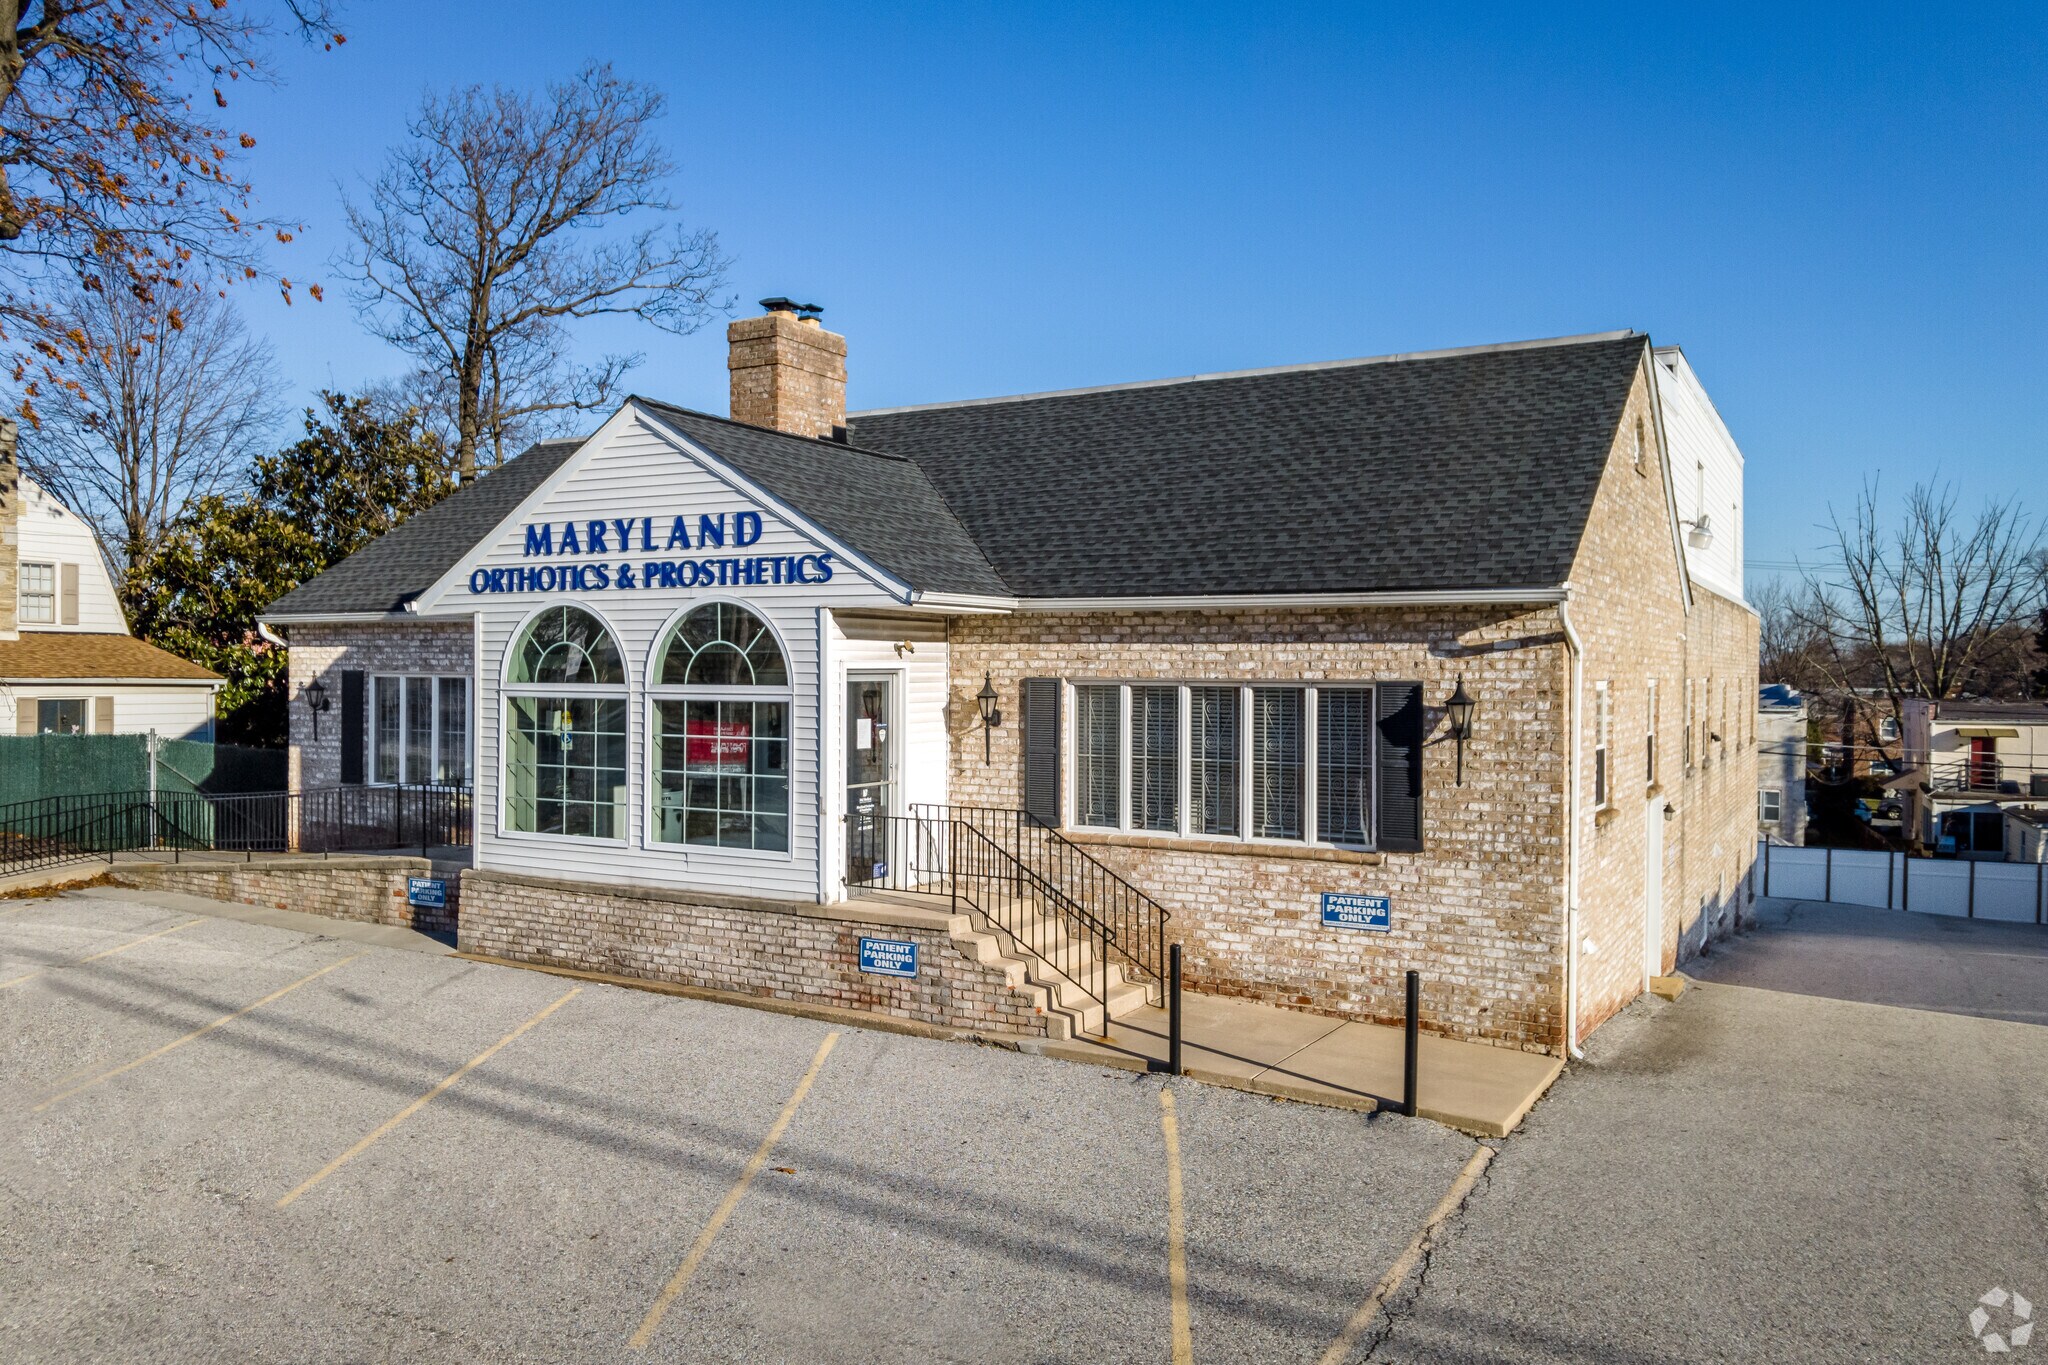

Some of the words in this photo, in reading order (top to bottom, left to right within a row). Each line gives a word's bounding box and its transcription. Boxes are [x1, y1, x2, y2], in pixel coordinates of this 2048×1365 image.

[523, 511, 763, 557] MARYLAND
[469, 563, 610, 594] ORTHOTICS
[615, 563, 637, 589] &
[642, 553, 834, 588] PROSTHETICS
[412, 880, 442, 889] PATIENT
[411, 887, 443, 896] PARKING
[417, 894, 436, 902] ONLY
[1328, 896, 1384, 907] PATIENT
[1326, 904, 1386, 917] PARKING
[1338, 913, 1373, 923] ONLY
[866, 941, 911, 954] PATIENT
[863, 950, 913, 963] PARKING
[873, 959, 902, 969] ONLY
